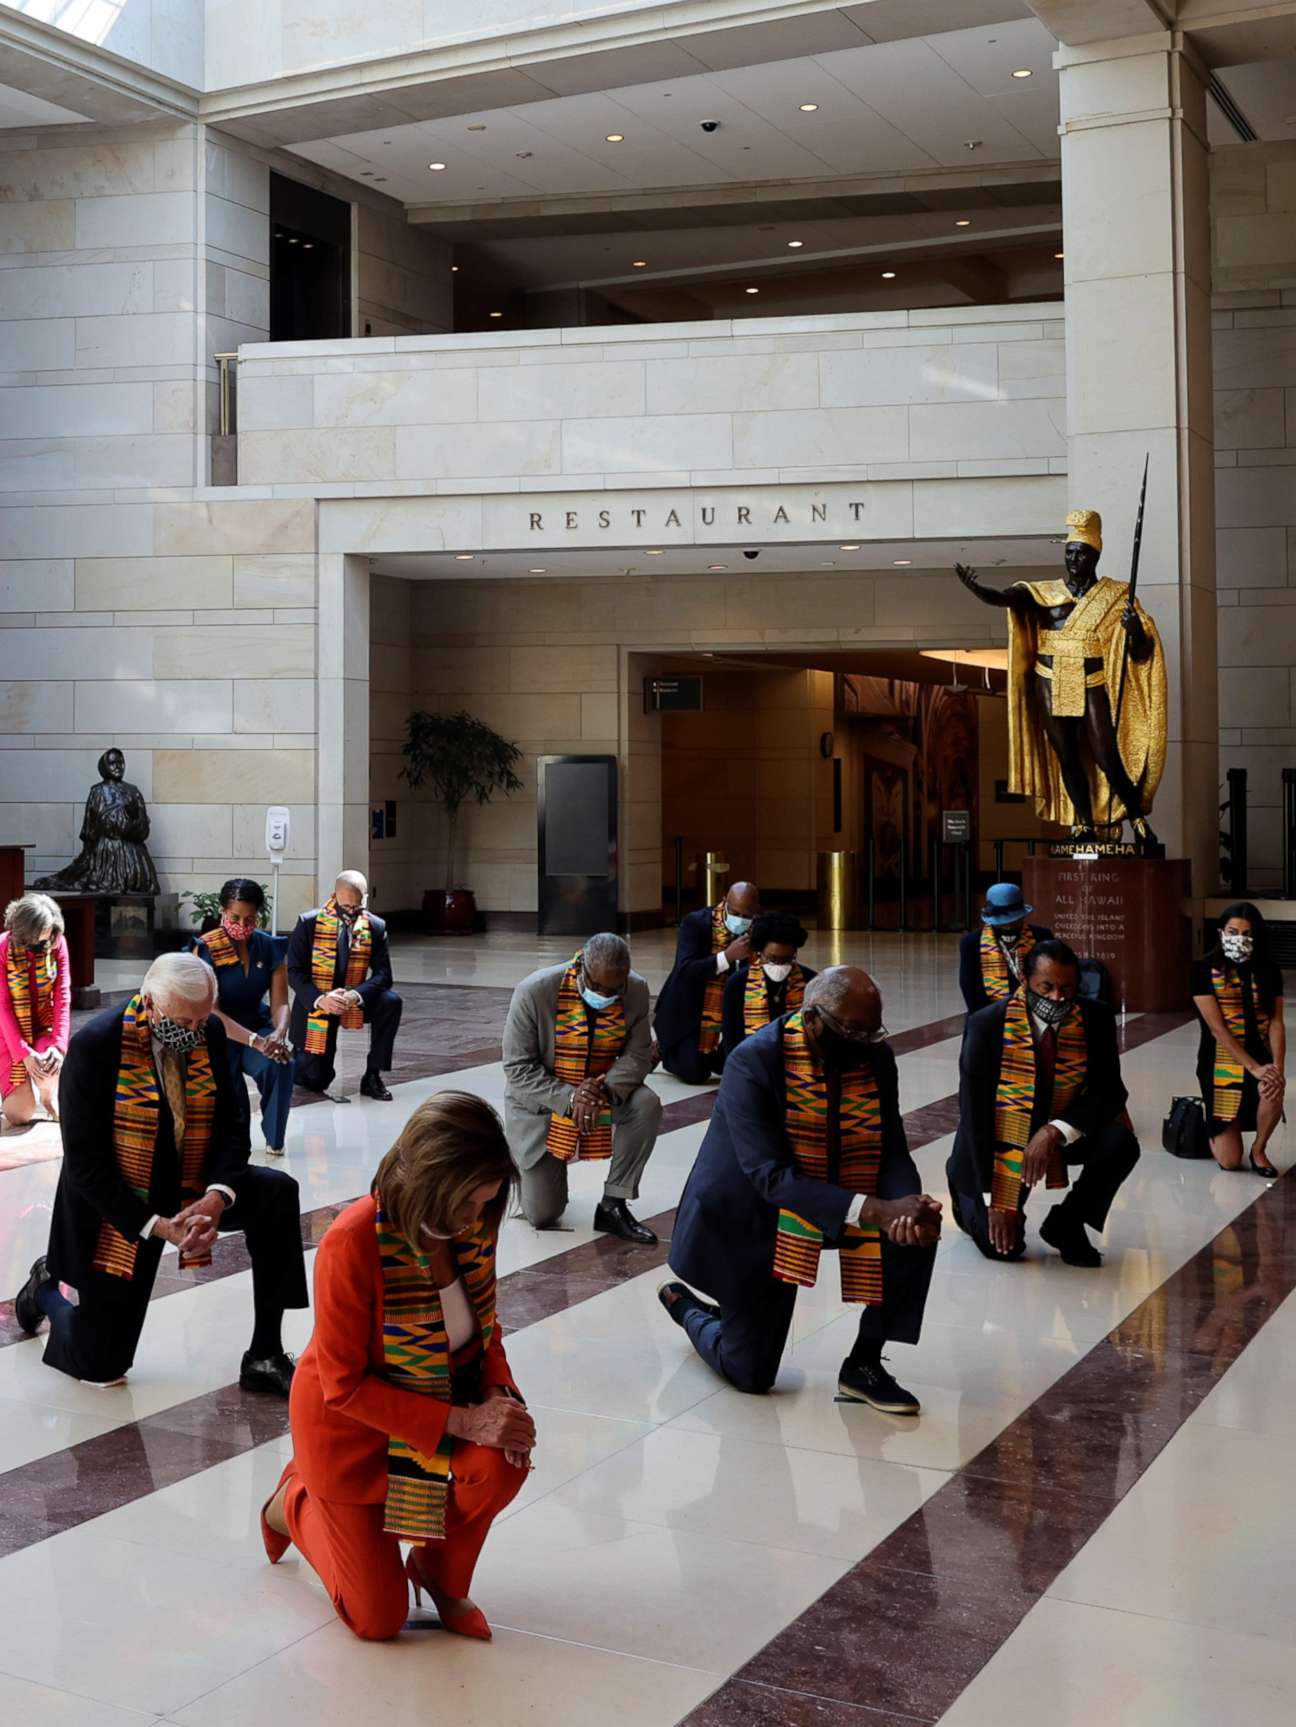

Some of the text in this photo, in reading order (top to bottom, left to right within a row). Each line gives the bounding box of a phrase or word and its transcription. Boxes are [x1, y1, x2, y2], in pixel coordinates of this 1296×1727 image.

[529, 502, 865, 530] RESTAURANT
[1058, 872, 1085, 881] FIRST
[1055, 895, 1074, 904] ALL
